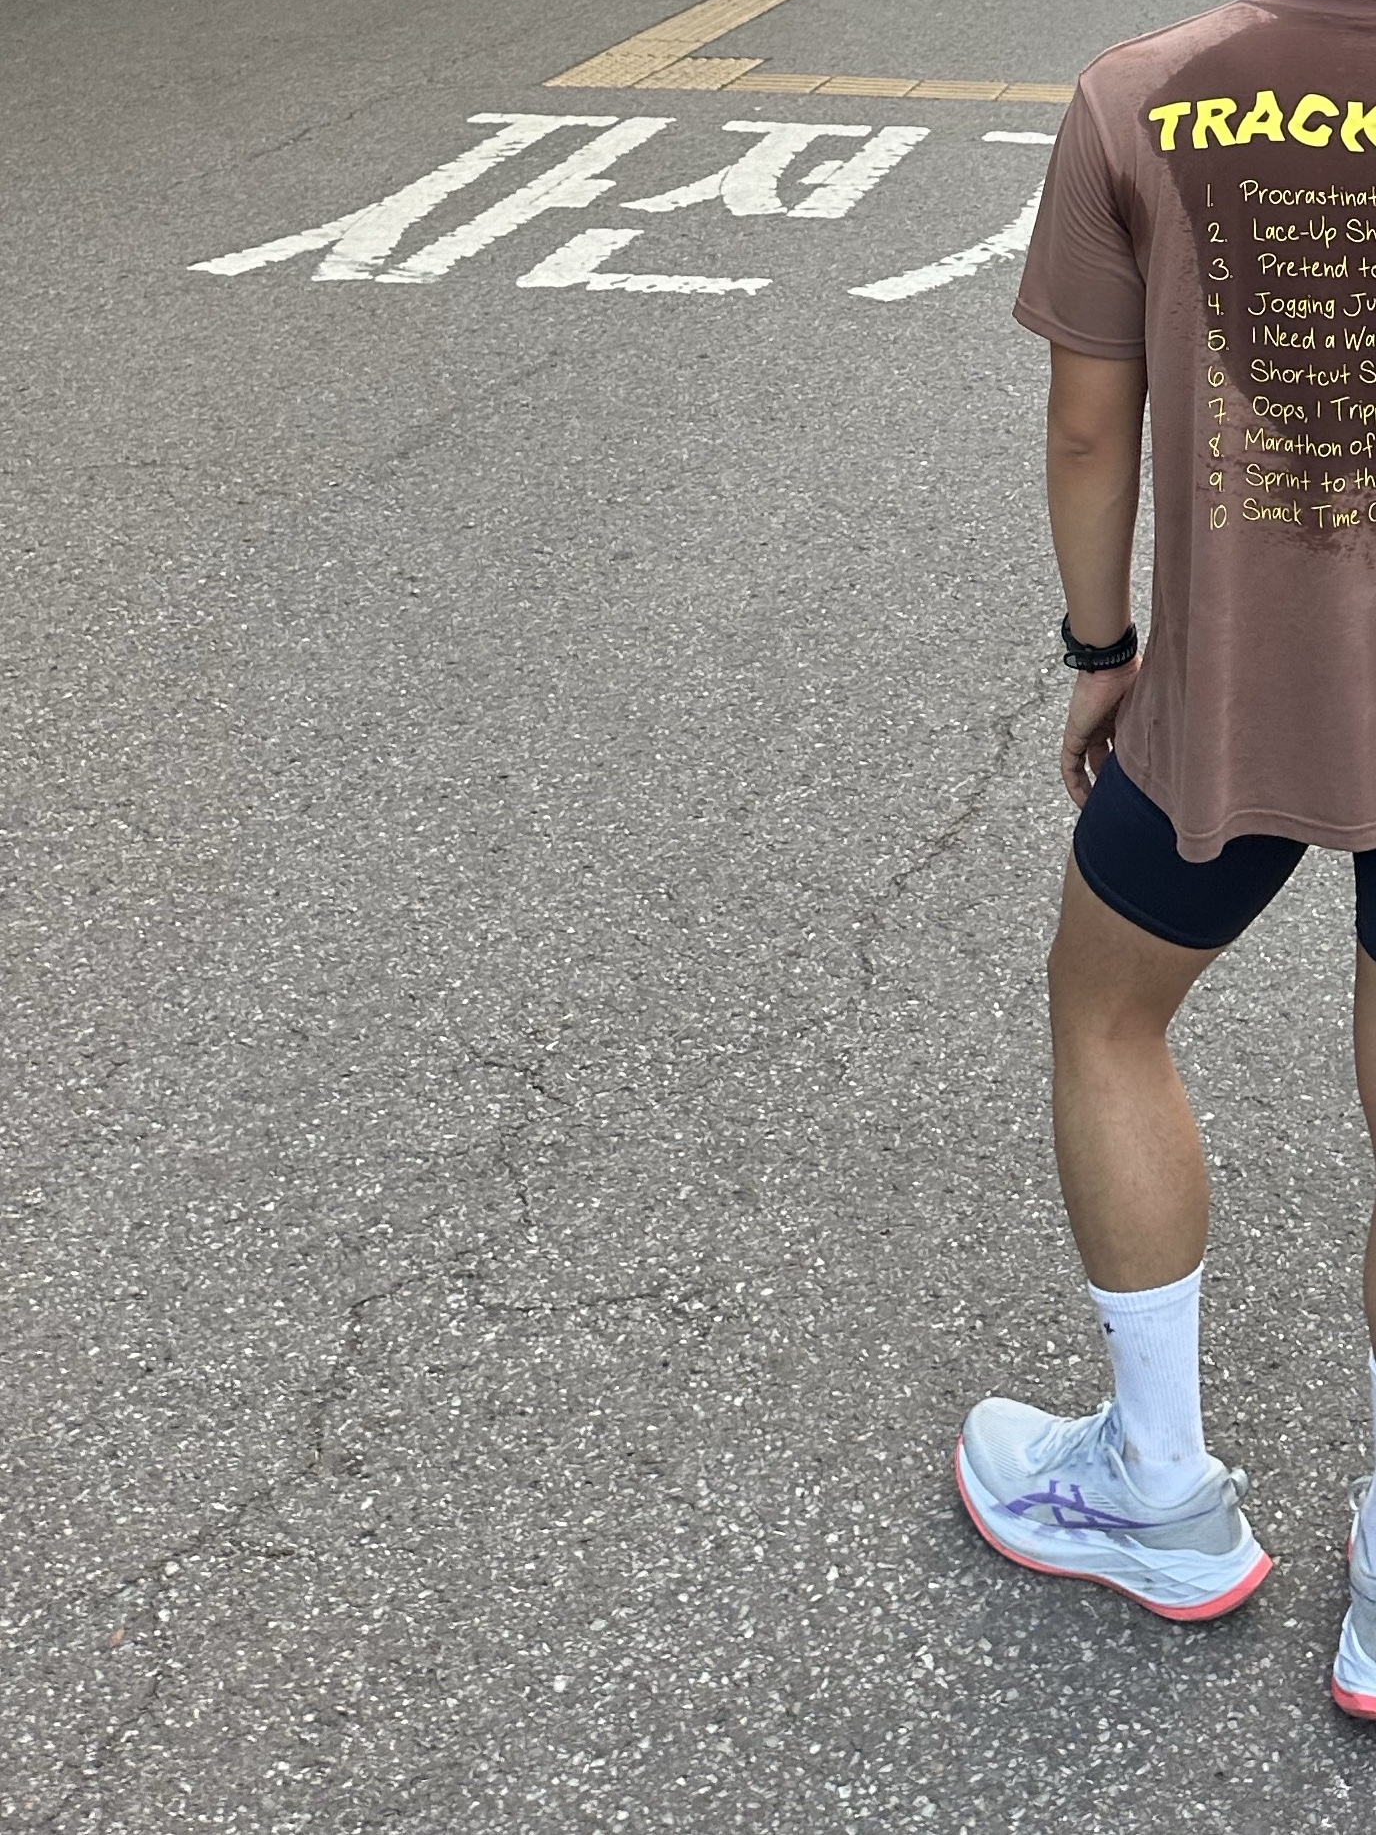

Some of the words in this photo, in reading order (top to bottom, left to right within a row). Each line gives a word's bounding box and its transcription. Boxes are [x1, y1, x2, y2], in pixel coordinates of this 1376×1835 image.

[1253, 218, 1336, 248] Lace-Up
[1258, 253, 1348, 278] Pretend
[1248, 292, 1334, 319] Jogging
[1264, 324, 1315, 349] Need
[1325, 335, 1335, 348] a
[1251, 359, 1351, 386] Shortcut
[1252, 396, 1309, 424] Oops,
[1245, 428, 1342, 457] Marathon
[1350, 432, 1375, 458] of
[1246, 464, 1311, 492] Sprint
[1321, 472, 1346, 492] to
[1243, 501, 1302, 525] Snack
[1311, 504, 1360, 527] Time
